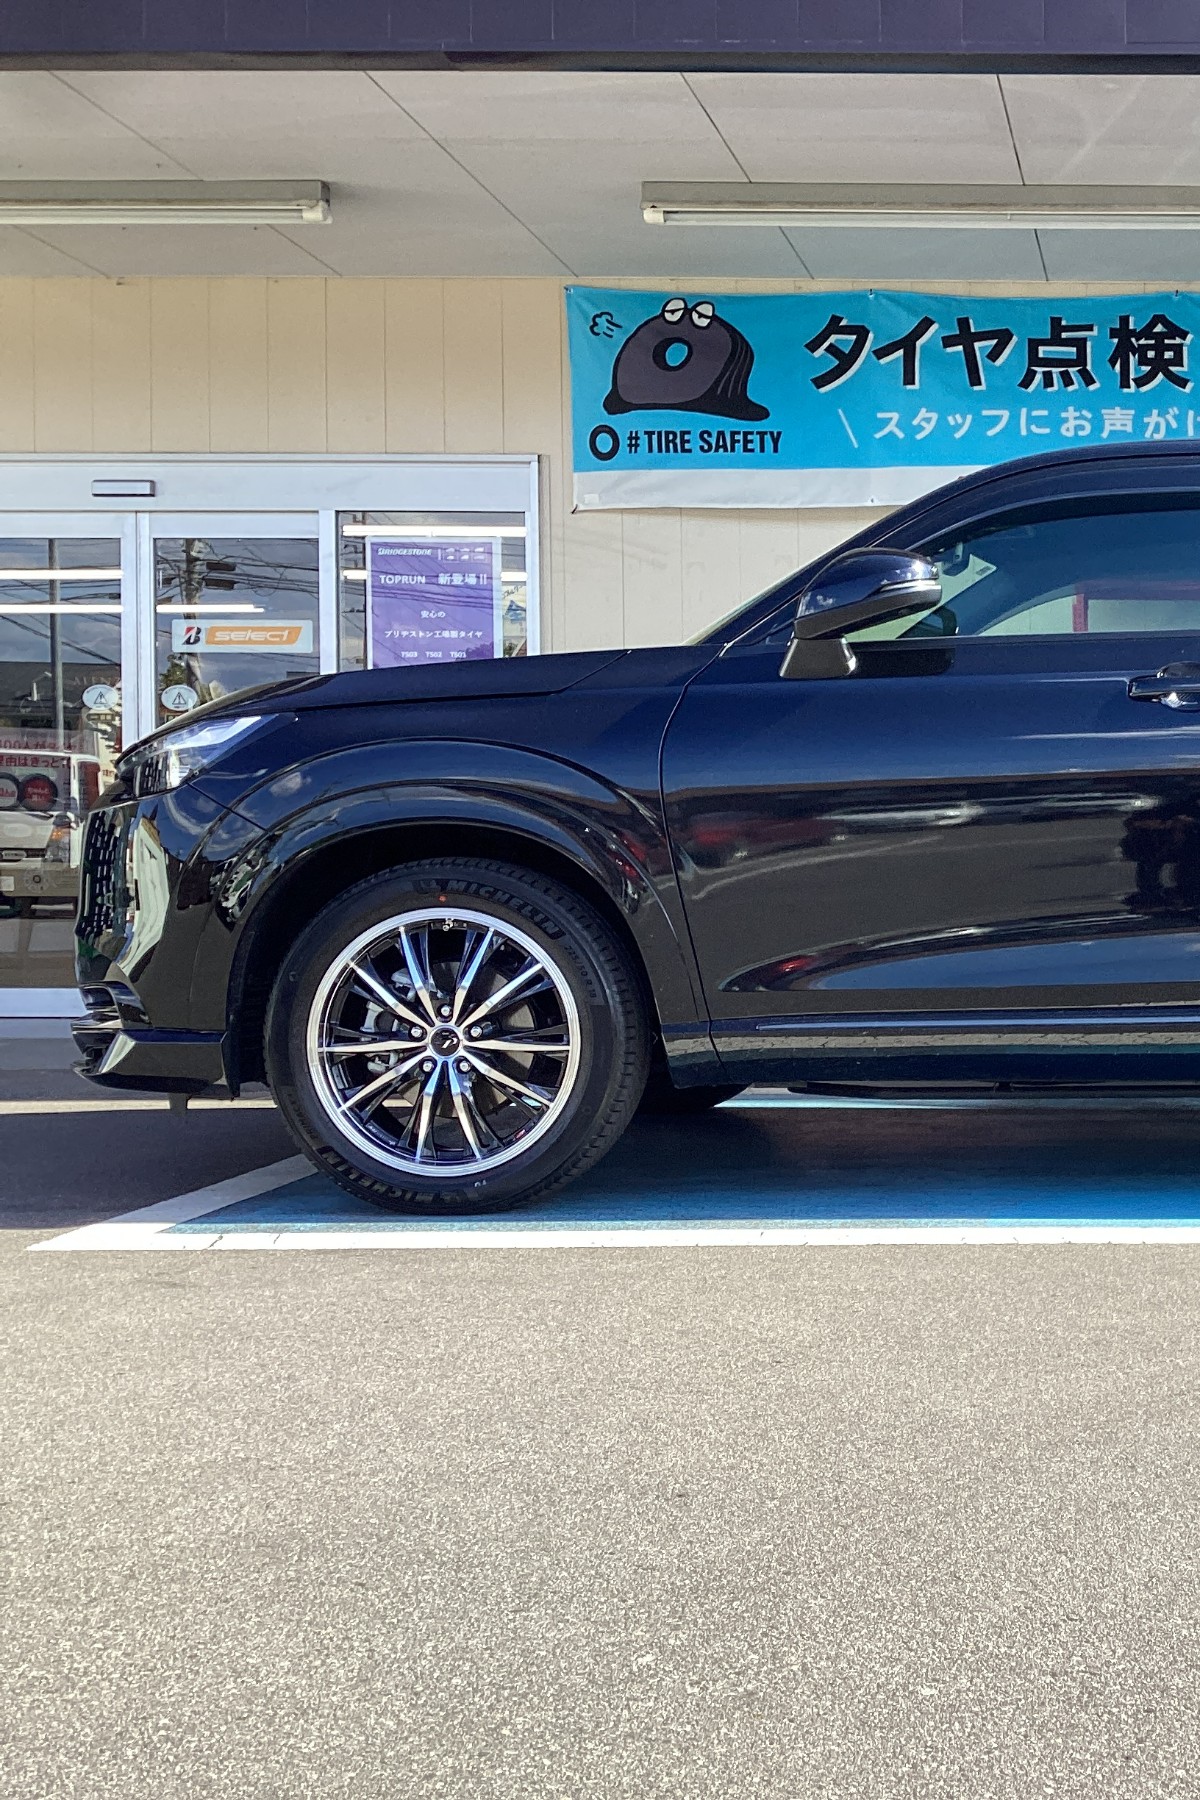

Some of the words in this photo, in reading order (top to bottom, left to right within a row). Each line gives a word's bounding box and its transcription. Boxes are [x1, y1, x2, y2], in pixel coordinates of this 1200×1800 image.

[804, 313, 1194, 392] タイヤ点検
[626, 429, 692, 454] #TIRE
[698, 429, 783, 454] SAFETY
[377, 547, 433, 556] BRIDGESTONE
[379, 574, 427, 585] TOPRUN
[420, 610, 446, 619] 安心の
[213, 628, 293, 642] select
